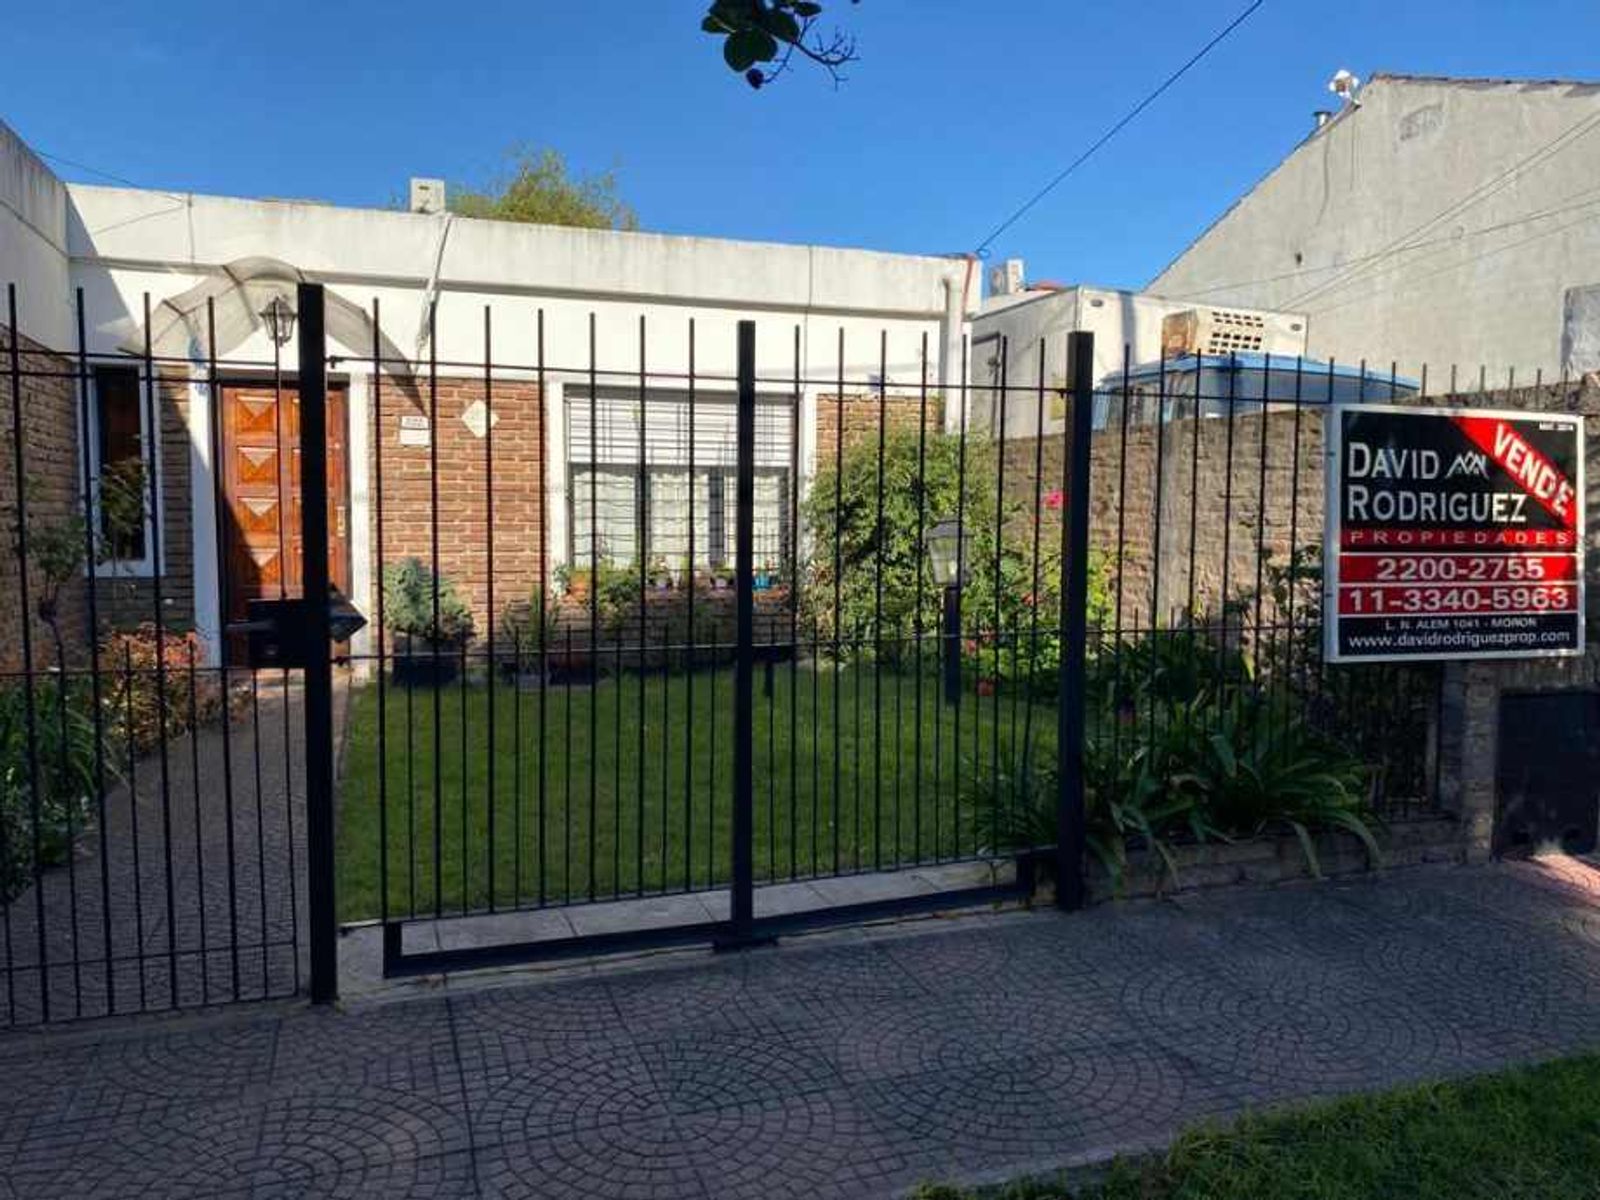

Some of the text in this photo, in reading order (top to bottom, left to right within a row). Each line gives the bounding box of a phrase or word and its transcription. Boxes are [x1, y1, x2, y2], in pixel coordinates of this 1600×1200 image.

[1348, 442, 1439, 480] DAVID
[1494, 424, 1574, 517] VENDE
[1347, 485, 1527, 523] RODRIGUEZ
[1350, 531, 1569, 544] PROPIEDADES
[1376, 558, 1545, 581] 2200-2755
[1350, 588, 1568, 612] 11-3340-5963
[1416, 619, 1449, 630] ALEM
[1453, 618, 1479, 629] 1041
[1491, 617, 1537, 628] MORON
[1349, 630, 1570, 648] www.davidrodriguezprop.com
